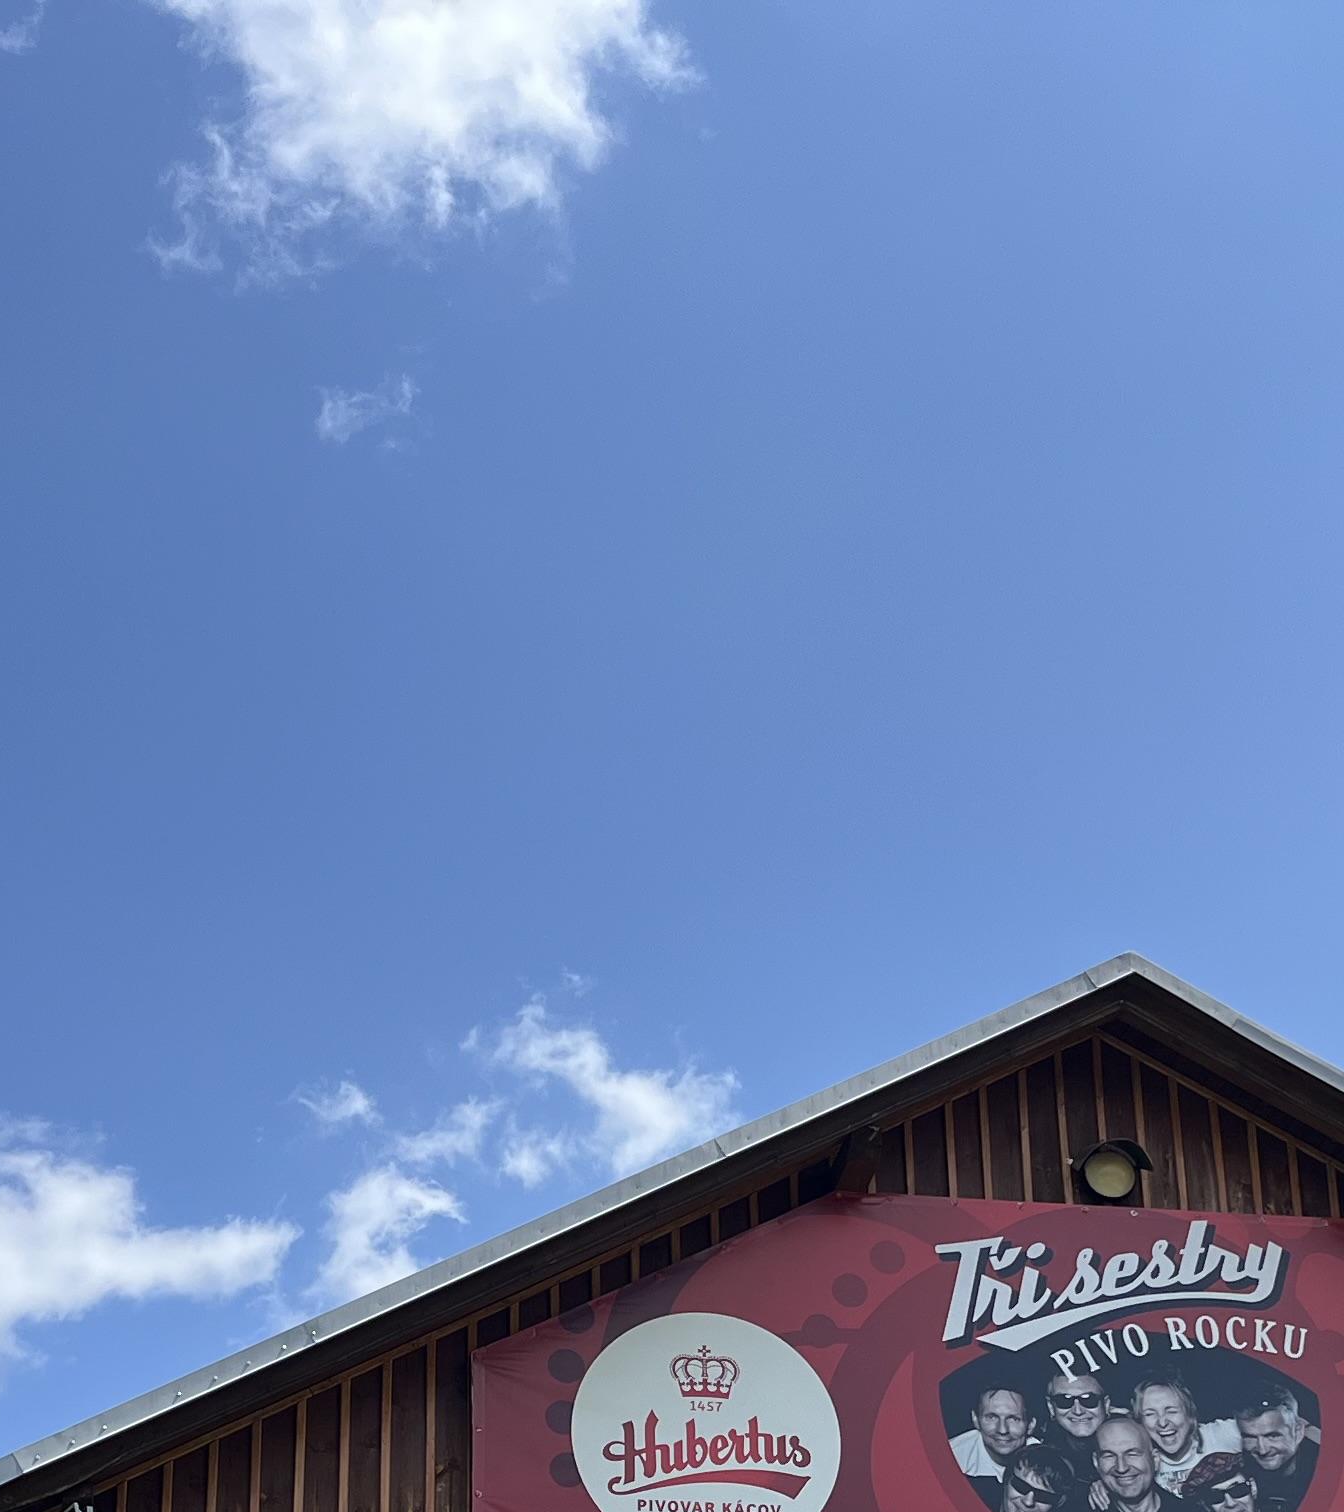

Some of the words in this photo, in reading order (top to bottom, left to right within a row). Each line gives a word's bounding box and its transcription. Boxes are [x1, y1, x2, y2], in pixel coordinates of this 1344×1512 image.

[934, 1236, 1052, 1342] Tři
[1053, 1219, 1284, 1309] sestry
[1050, 1322, 1150, 1384] PIVO
[1163, 1314, 1309, 1359] ROCKU
[689, 1400, 723, 1413] 1457
[602, 1409, 812, 1486] Hubertus
